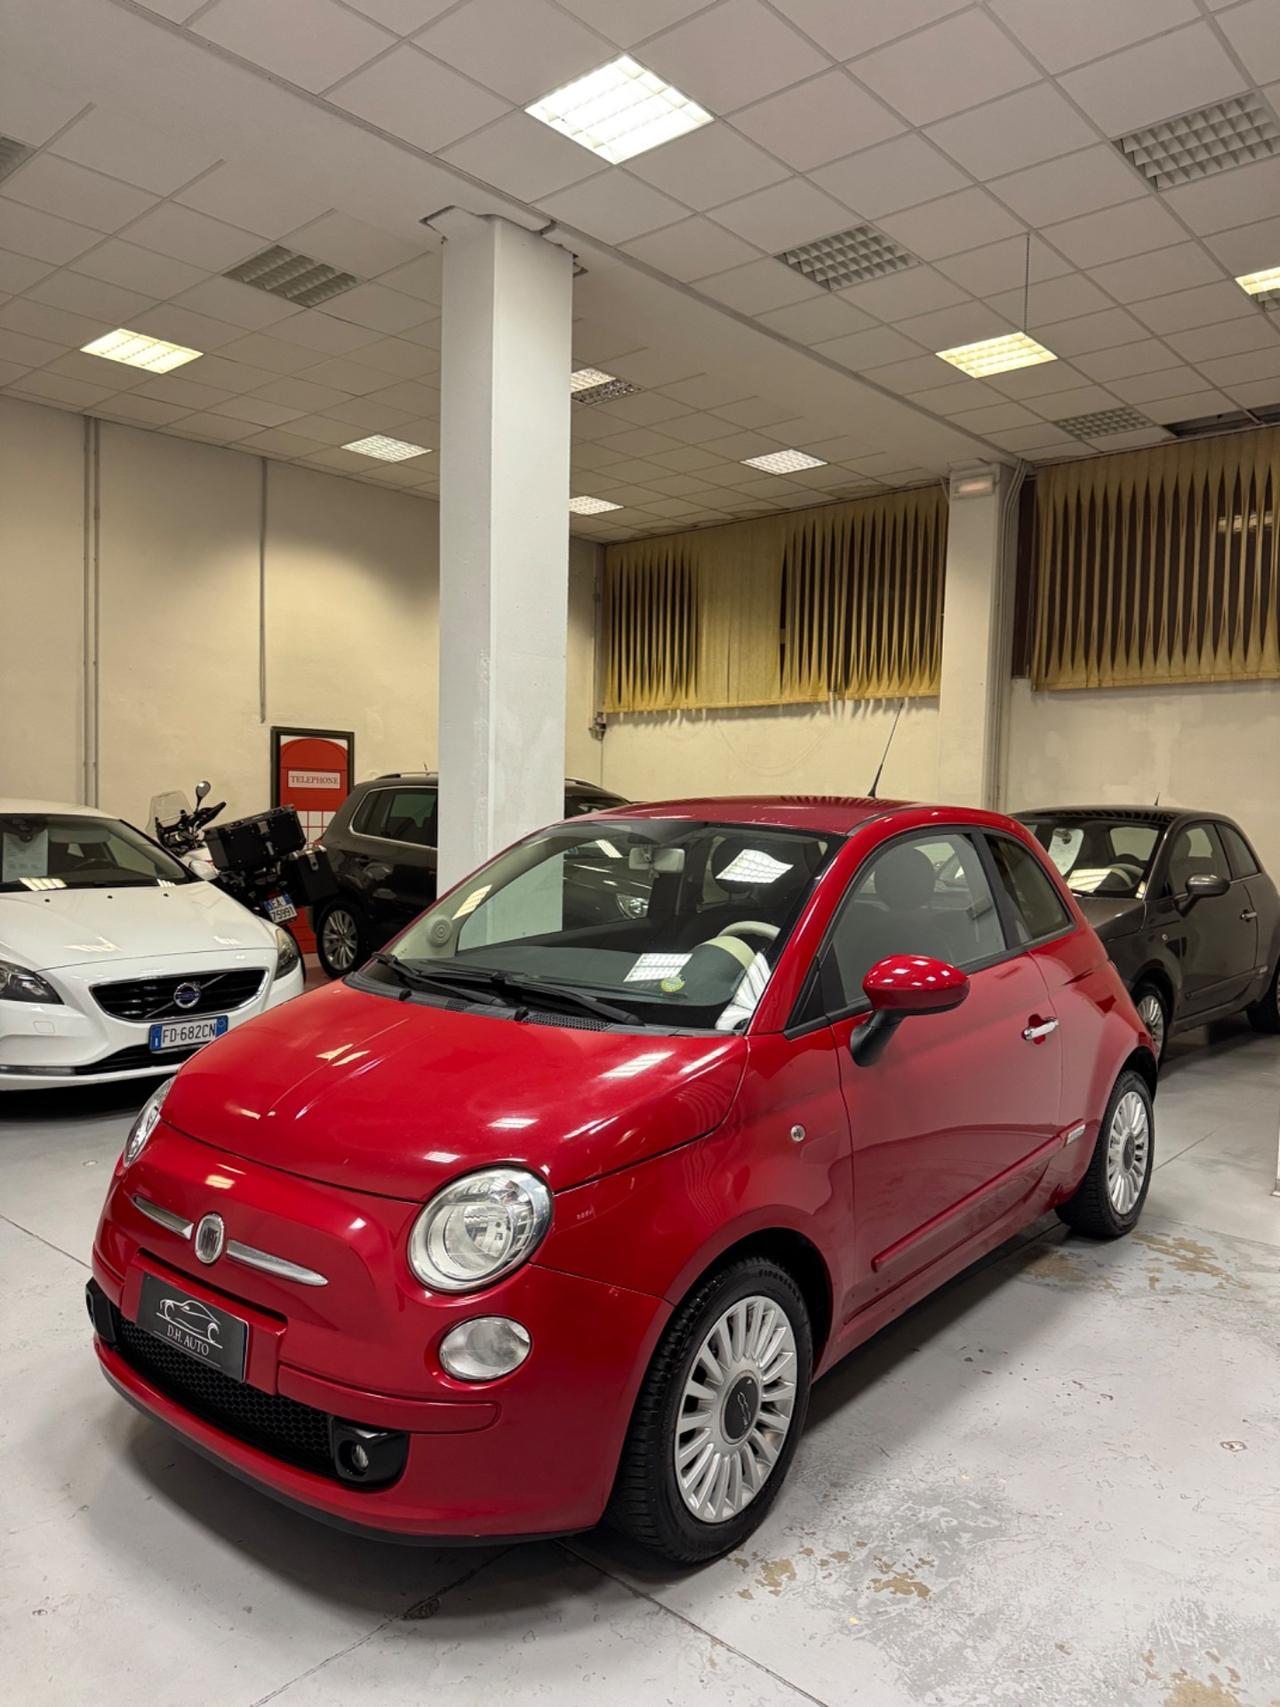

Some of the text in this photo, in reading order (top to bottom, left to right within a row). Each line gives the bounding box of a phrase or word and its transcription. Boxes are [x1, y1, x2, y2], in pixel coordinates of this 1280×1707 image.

[290, 775, 339, 785] TELEPHONE
[166, 1324, 209, 1356] D.H. AUTO
